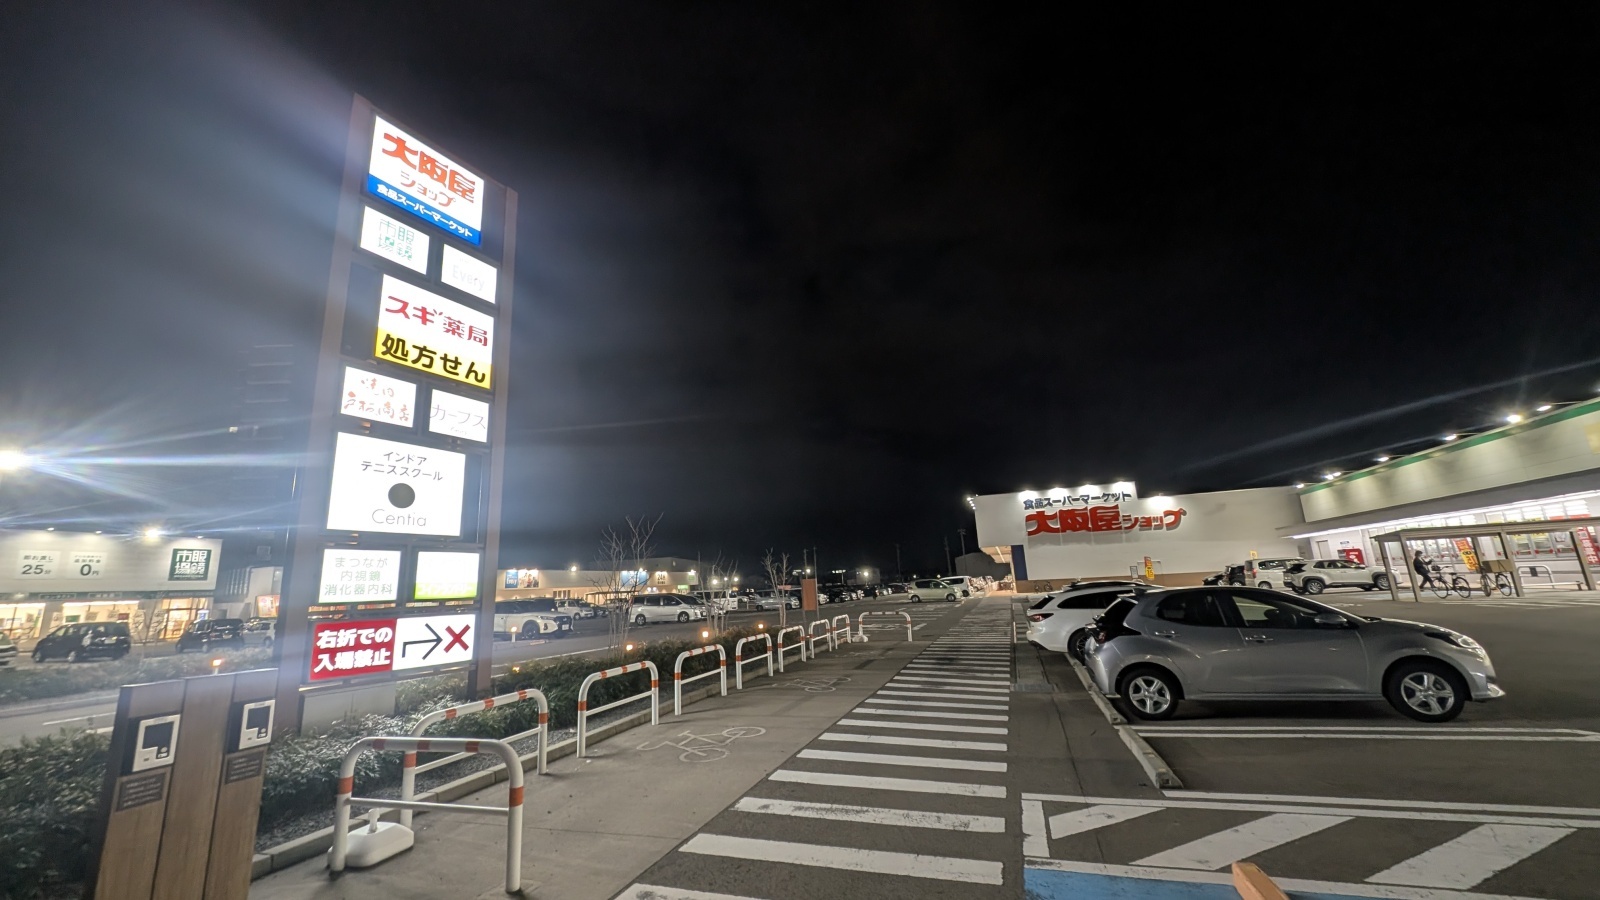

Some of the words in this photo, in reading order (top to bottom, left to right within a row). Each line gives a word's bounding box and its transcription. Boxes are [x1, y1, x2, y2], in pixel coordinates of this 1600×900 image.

[382, 132, 475, 203] 大阪屋
[400, 170, 456, 207] ショップ
[376, 183, 473, 237] 食品スーパーマーケット
[385, 295, 488, 347] スギ薬局
[381, 333, 486, 384] 処方せん
[384, 451, 427, 466] インドア
[360, 460, 443, 481] テニススクール
[1023, 490, 1132, 510] 食品スーパーマーケット
[371, 508, 427, 527] Centia
[335, 557, 388, 569] まつなが
[340, 570, 381, 582] 内視鏡
[324, 583, 393, 597] 消化器内科
[316, 627, 393, 649] 右折での
[313, 649, 391, 673] 入場禁止
